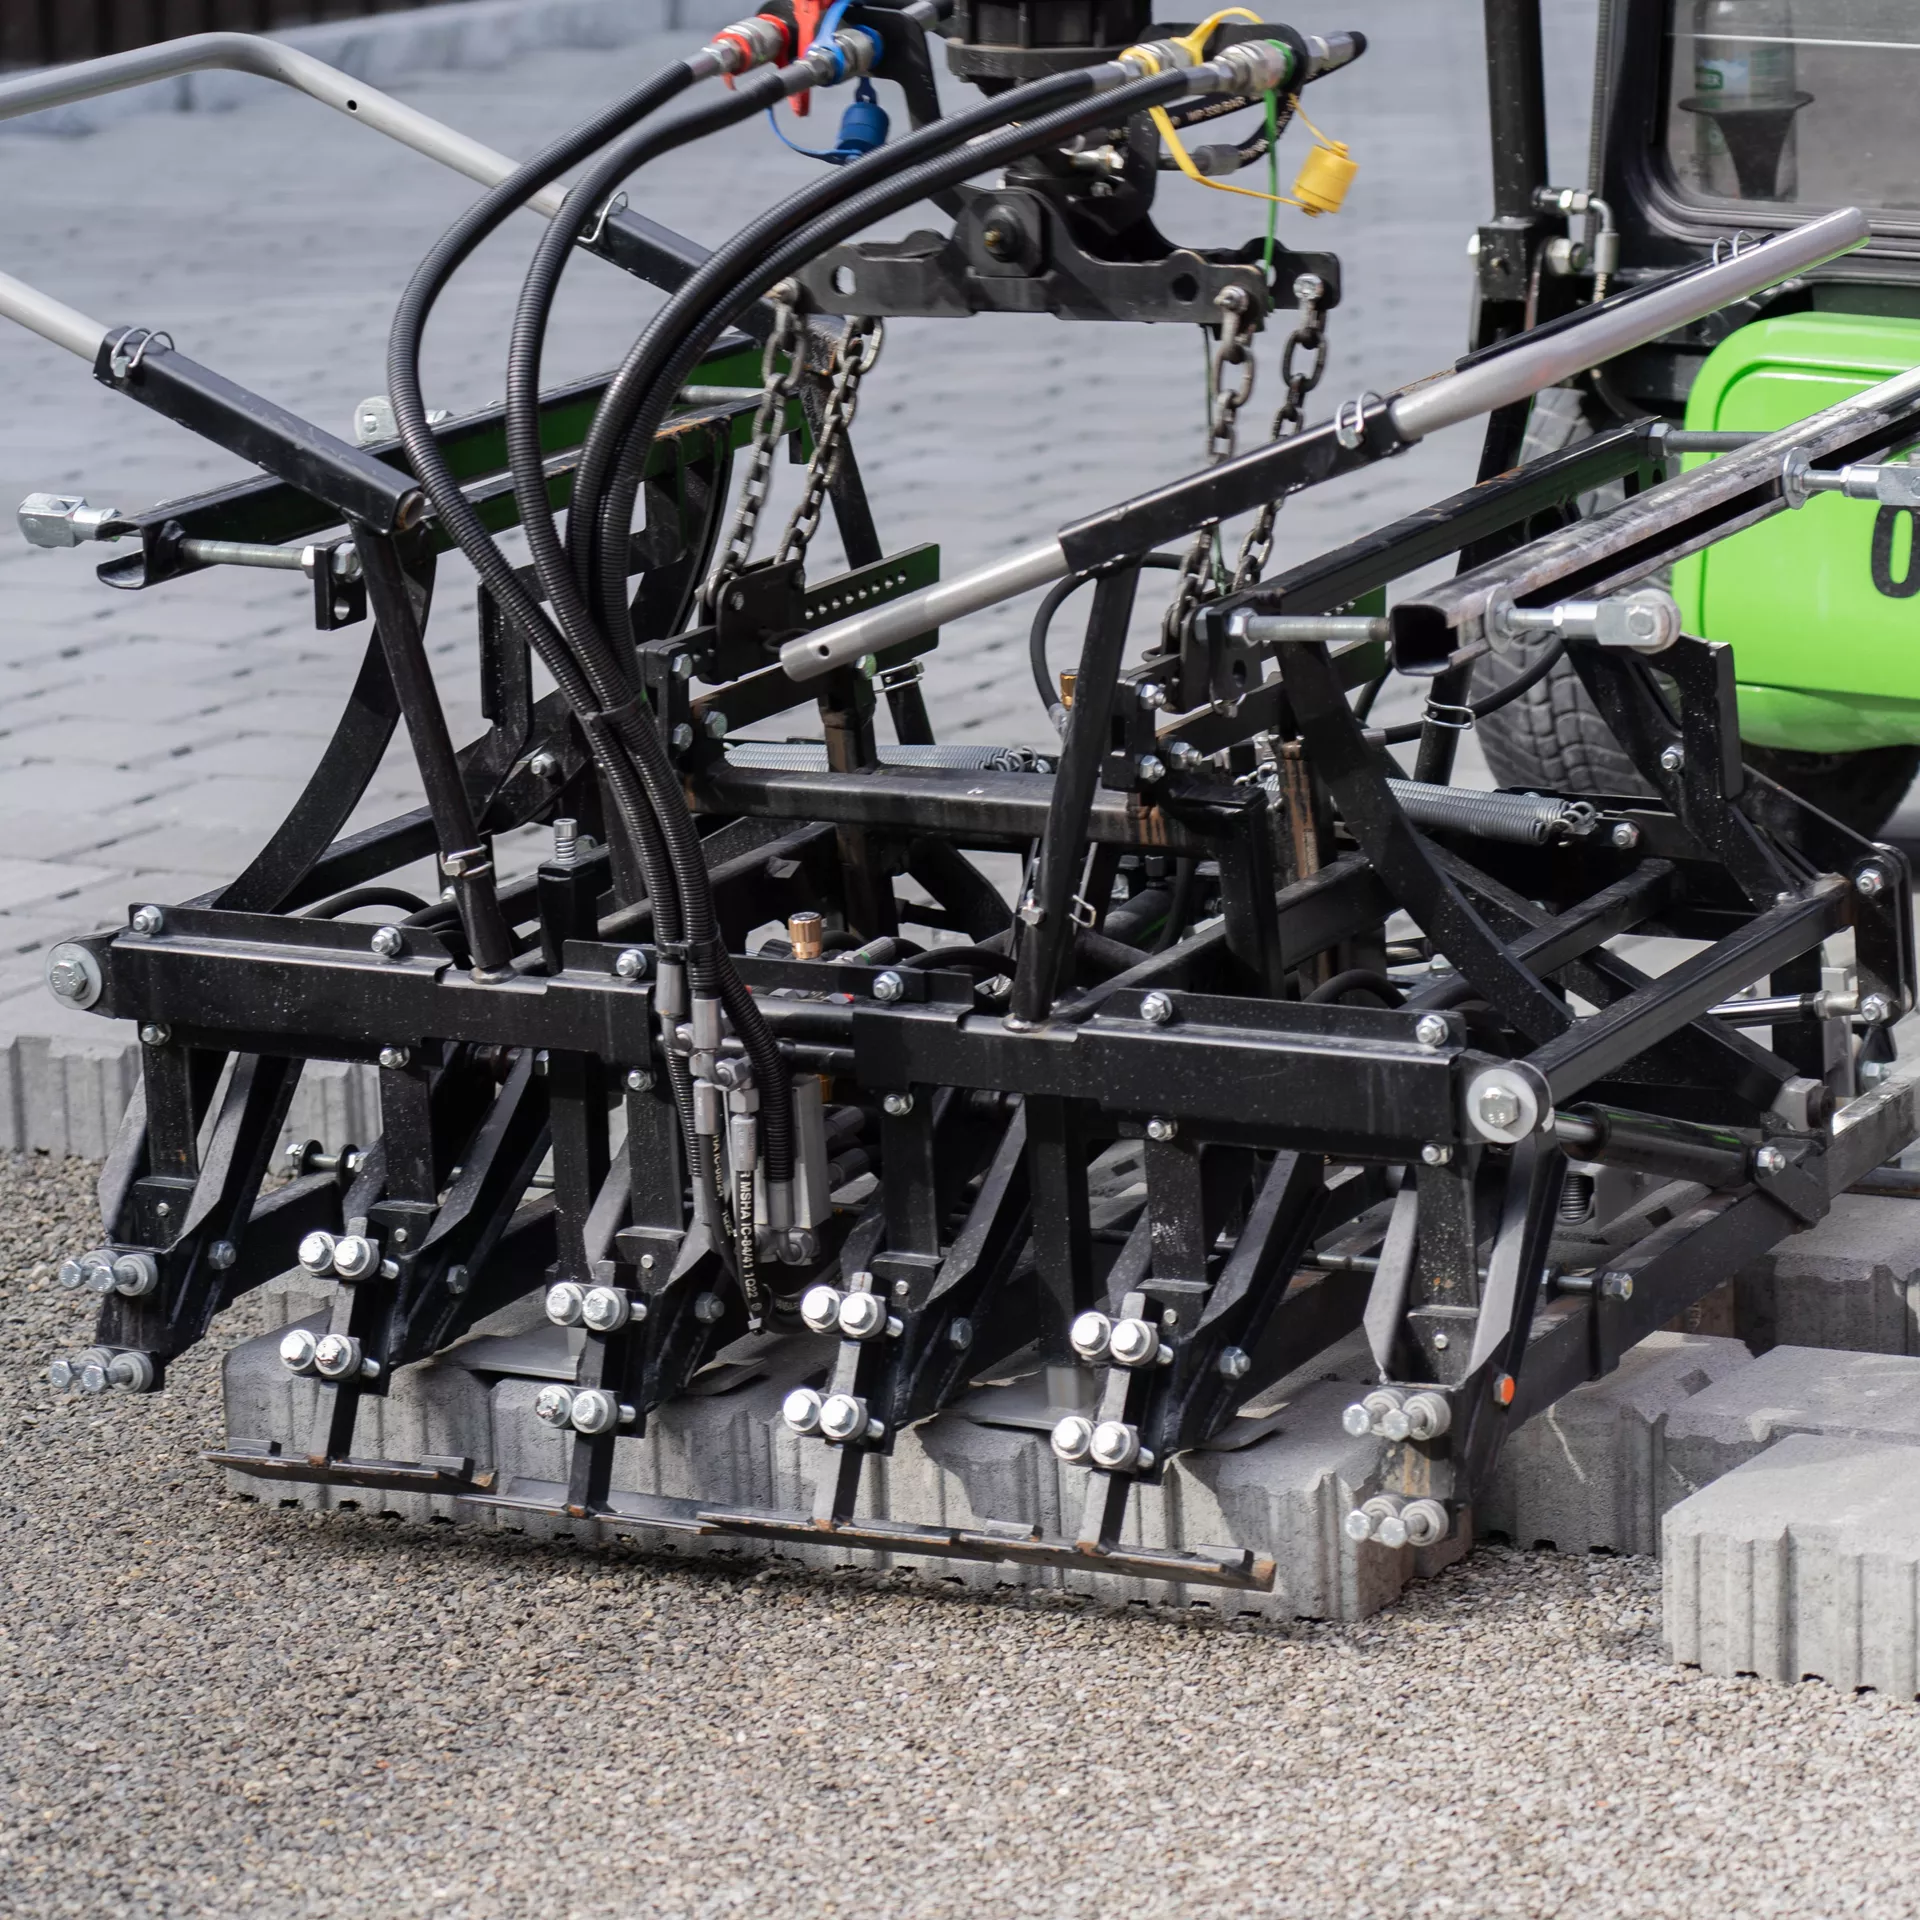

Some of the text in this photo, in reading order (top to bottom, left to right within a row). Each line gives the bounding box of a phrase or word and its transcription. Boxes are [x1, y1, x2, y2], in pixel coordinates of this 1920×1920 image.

[740, 1181, 752, 1220] MSHA
[740, 1222, 754, 1269] IC-84/41
[744, 1272, 759, 1299] 1Q22
